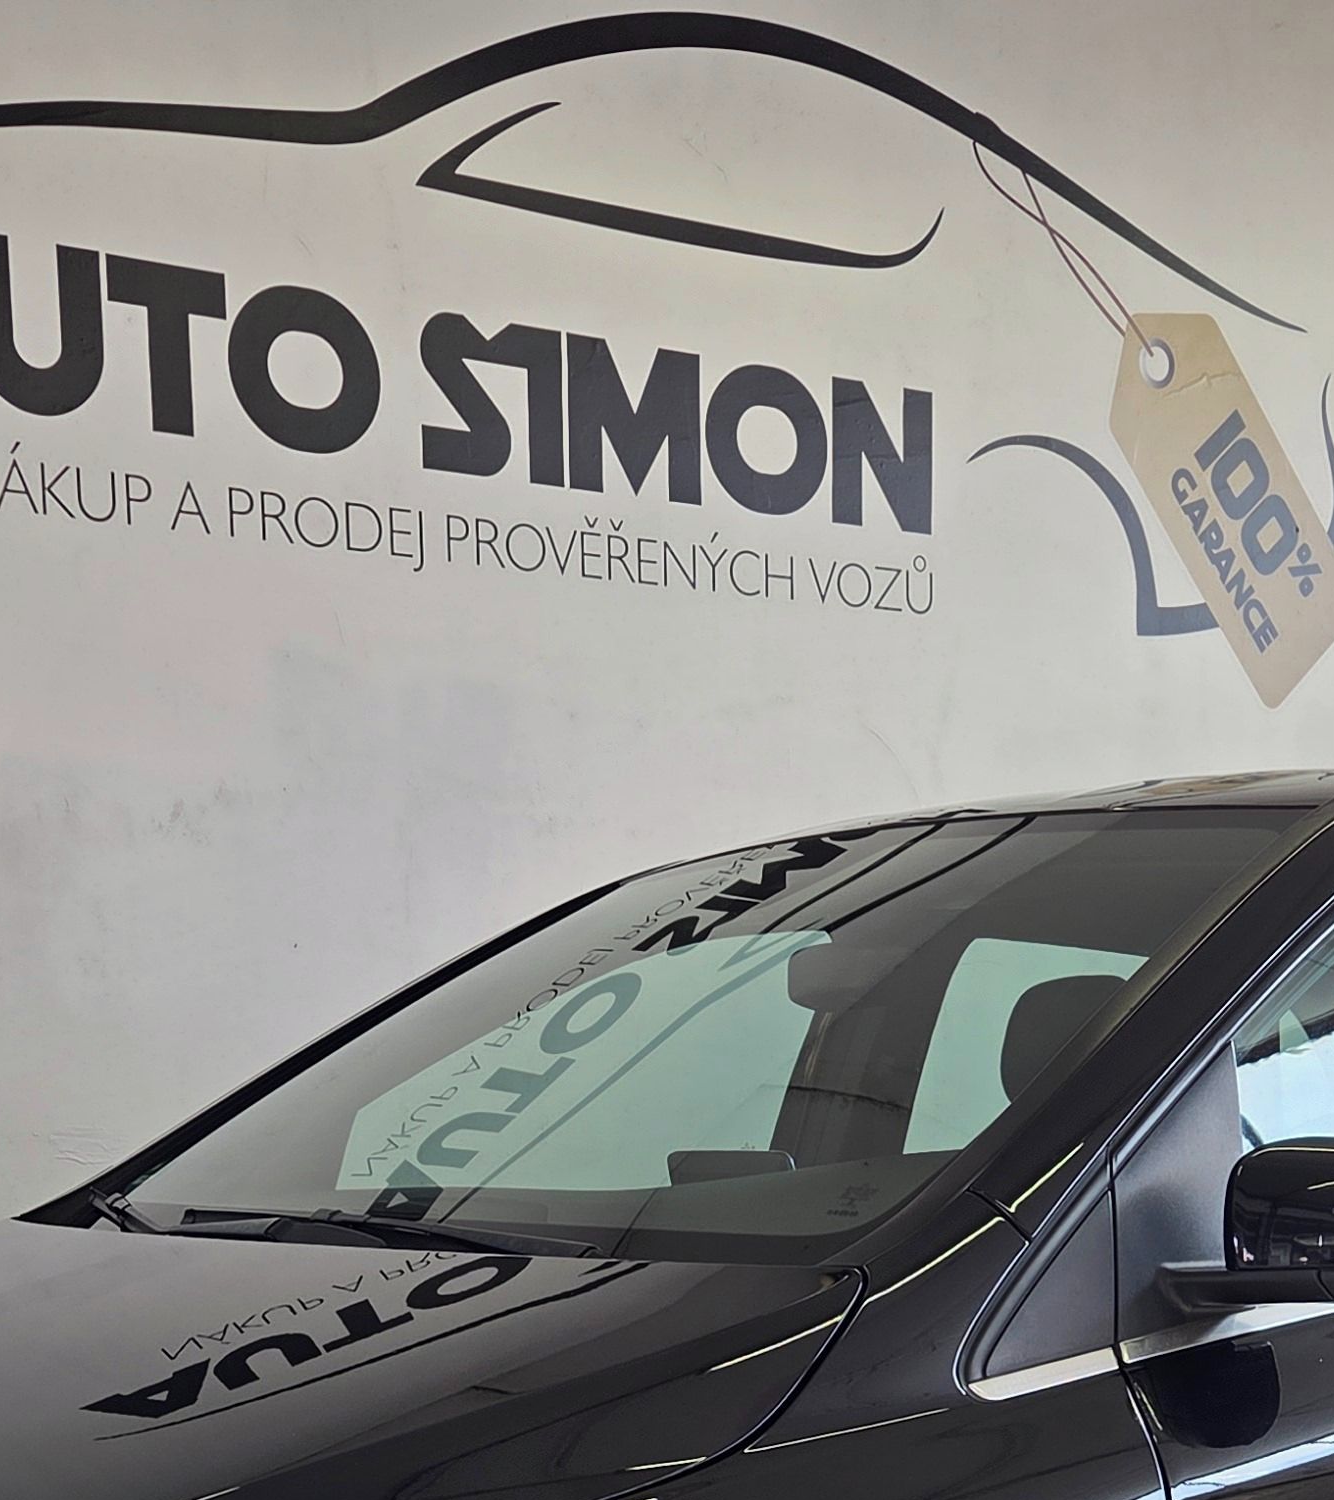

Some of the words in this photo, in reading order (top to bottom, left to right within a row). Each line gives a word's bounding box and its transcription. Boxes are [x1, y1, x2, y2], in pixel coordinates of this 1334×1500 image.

[420, 311, 933, 536] SIMON
[1193, 408, 1322, 597] 100%
[171, 481, 211, 535] A
[228, 486, 426, 572] PRODEJ
[446, 513, 795, 601] PROVĚŘENÝCH
[809, 555, 933, 615] VOZŮ
[1171, 467, 1278, 654] GARANCE
